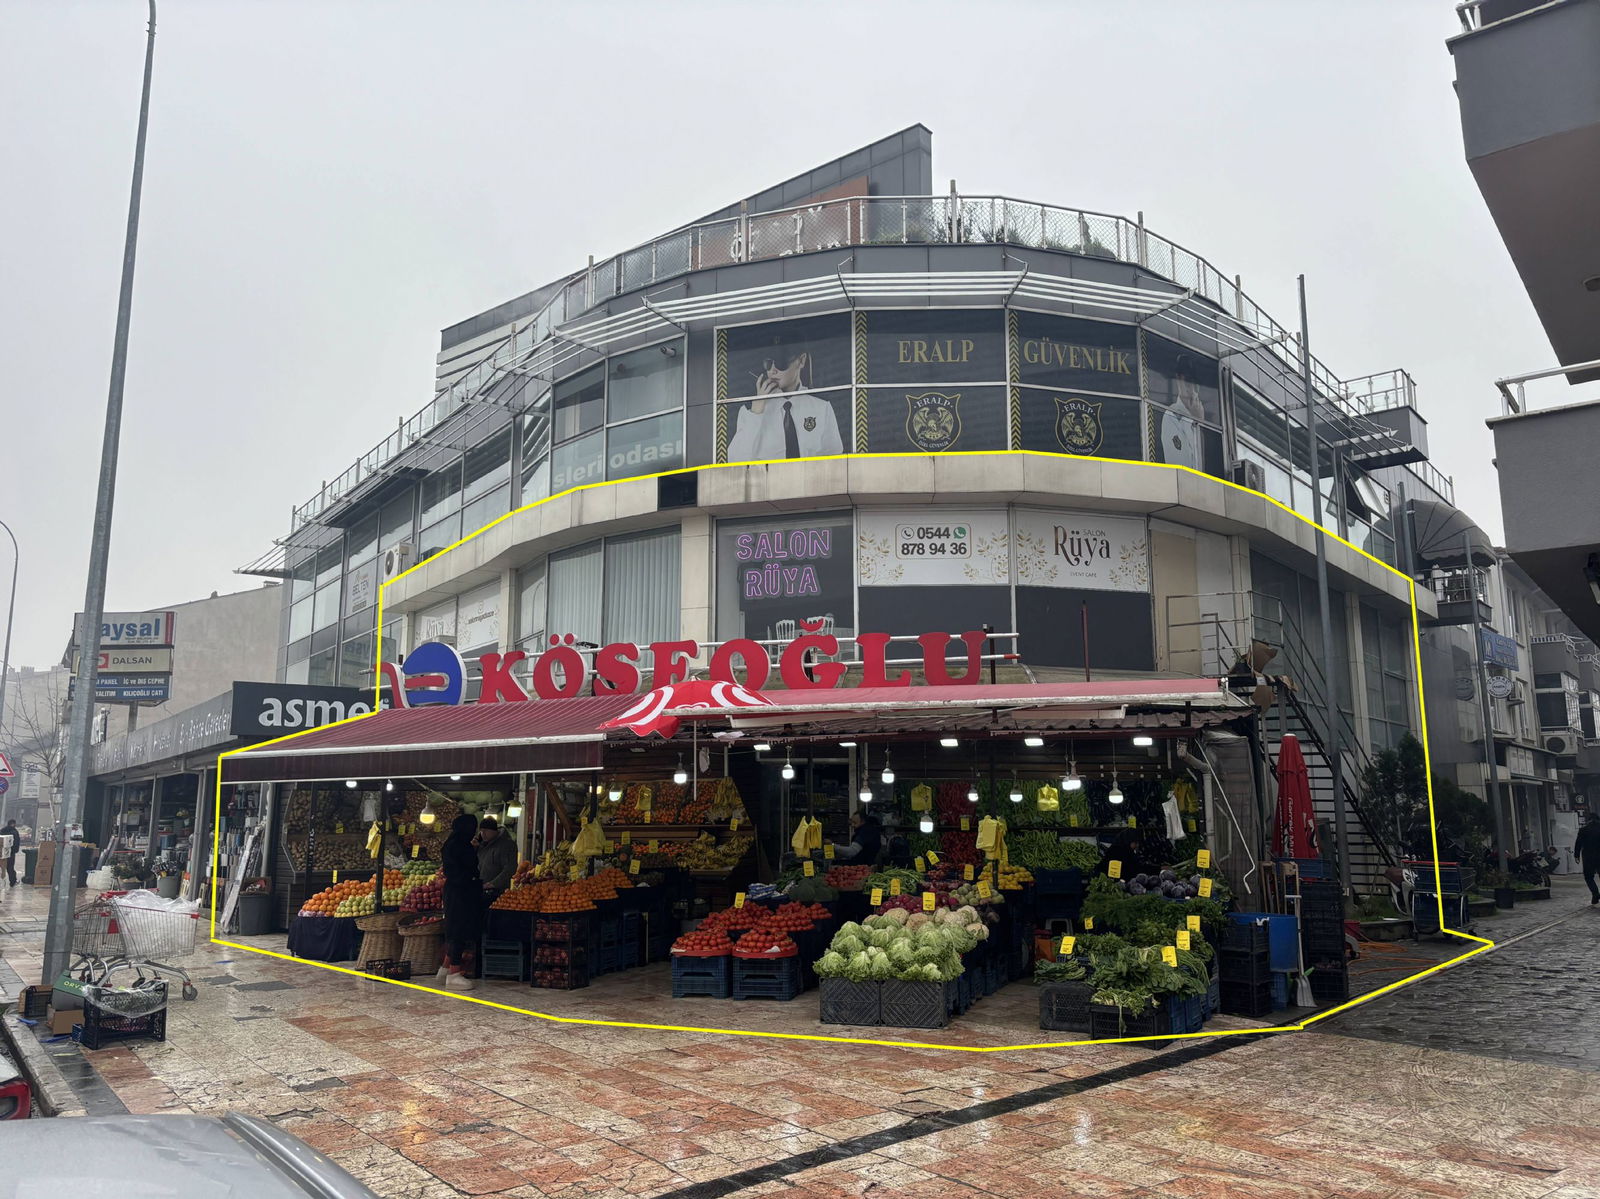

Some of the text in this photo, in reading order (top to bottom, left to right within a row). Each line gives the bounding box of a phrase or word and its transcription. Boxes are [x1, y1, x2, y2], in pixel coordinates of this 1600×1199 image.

[897, 336, 1132, 375] ERALP GÜVENLİK
[916, 396, 952, 409] ERALP
[1063, 403, 1095, 415] ERALP
[917, 527, 950, 540] 0544
[1082, 529, 1106, 537] SALON
[736, 529, 831, 560] SALON
[901, 543, 967, 556] 878 94 36
[1053, 525, 1111, 566] Rüya
[745, 563, 818, 597] RÜYA
[101, 618, 161, 641] aysal
[112, 656, 153, 665] DALSAN
